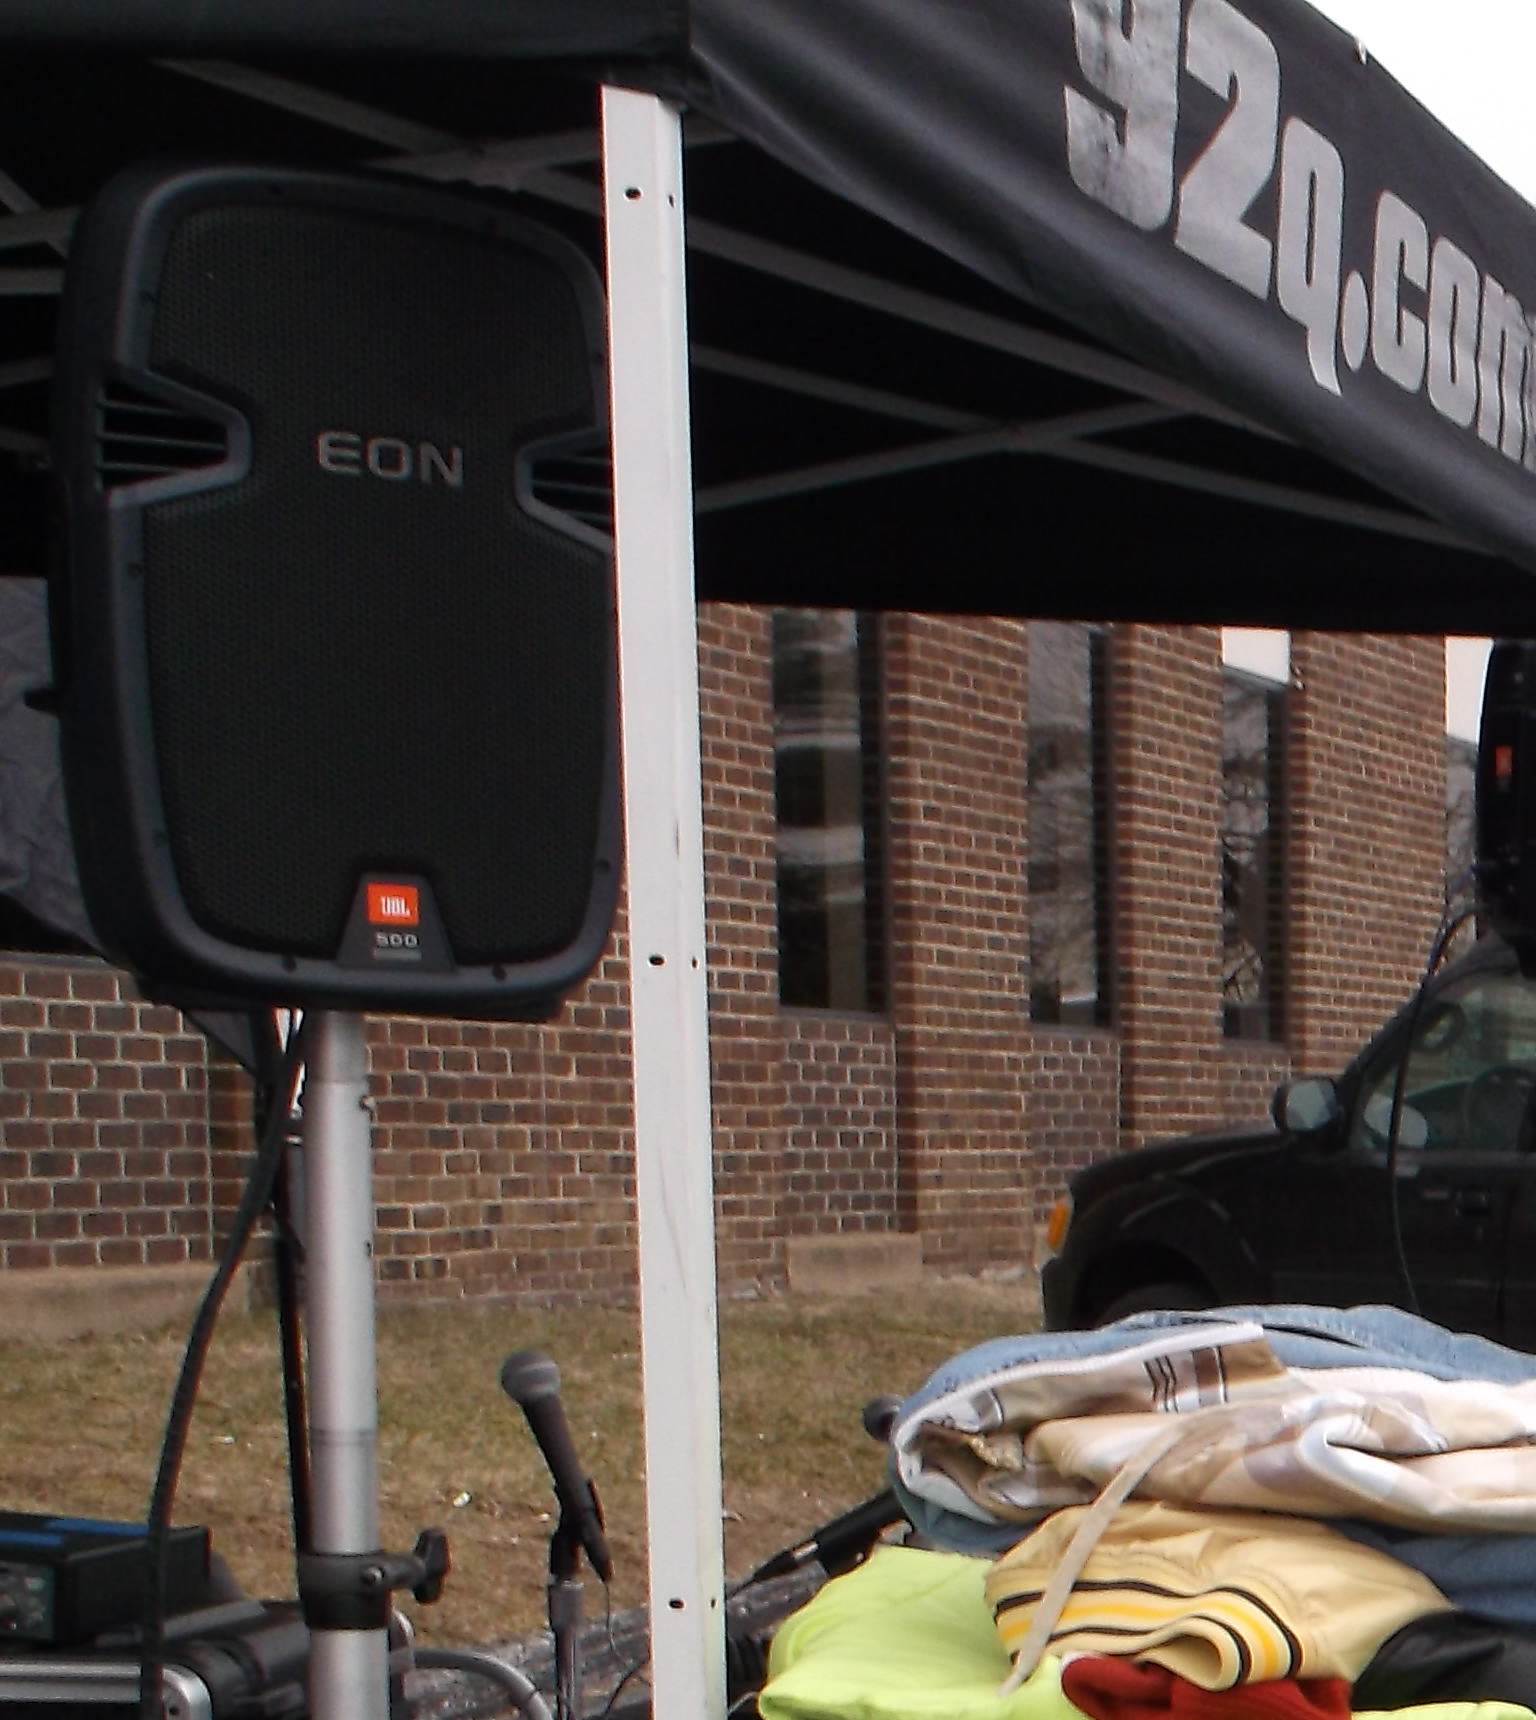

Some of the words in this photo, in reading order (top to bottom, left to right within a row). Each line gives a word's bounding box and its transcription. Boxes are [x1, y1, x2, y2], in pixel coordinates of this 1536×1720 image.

[317, 431, 463, 487] EON
[381, 895, 412, 918] JBL
[375, 931, 419, 950] 500
